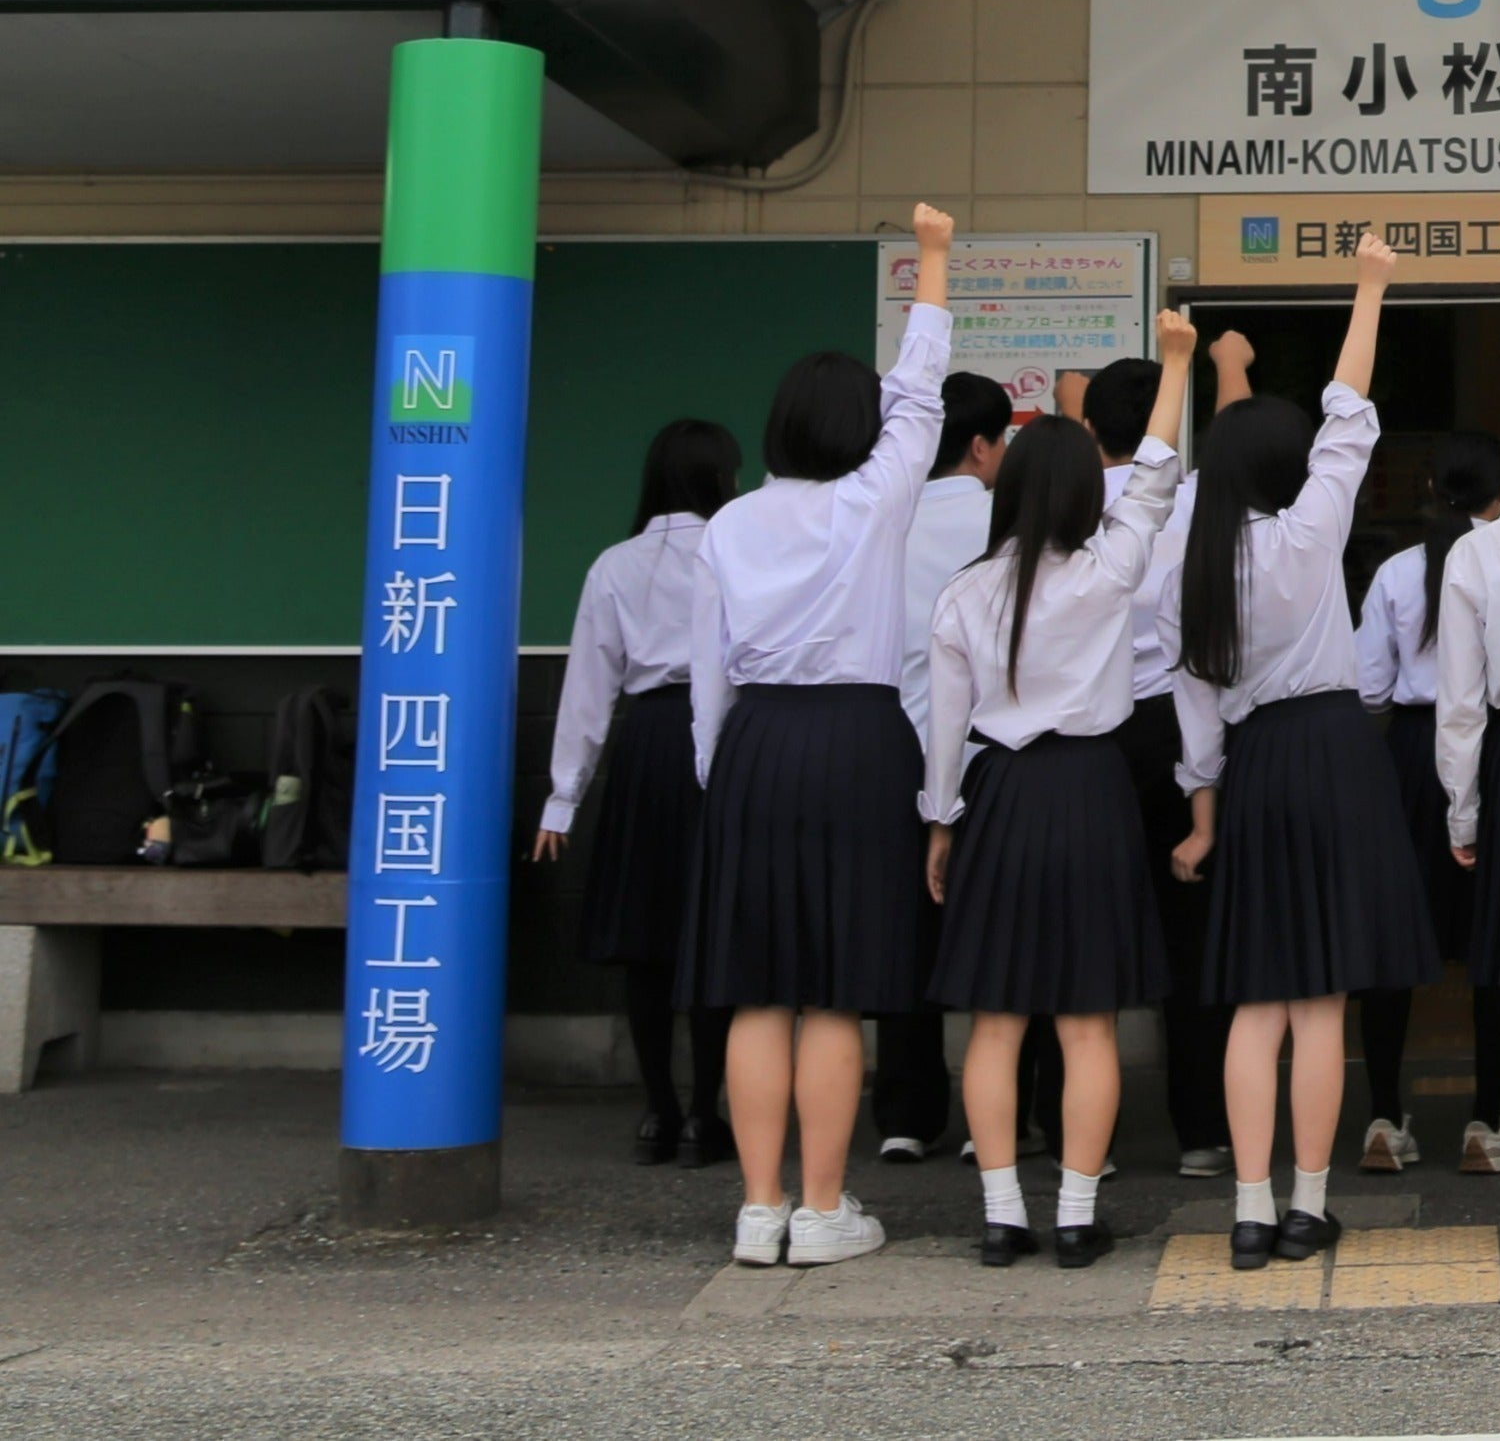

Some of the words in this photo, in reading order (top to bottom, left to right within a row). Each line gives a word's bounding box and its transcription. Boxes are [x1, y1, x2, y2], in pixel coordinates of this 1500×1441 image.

[404, 349, 455, 410] N
[388, 425, 470, 445] NISSHIN
[359, 474, 457, 1074] 日新四国工場
